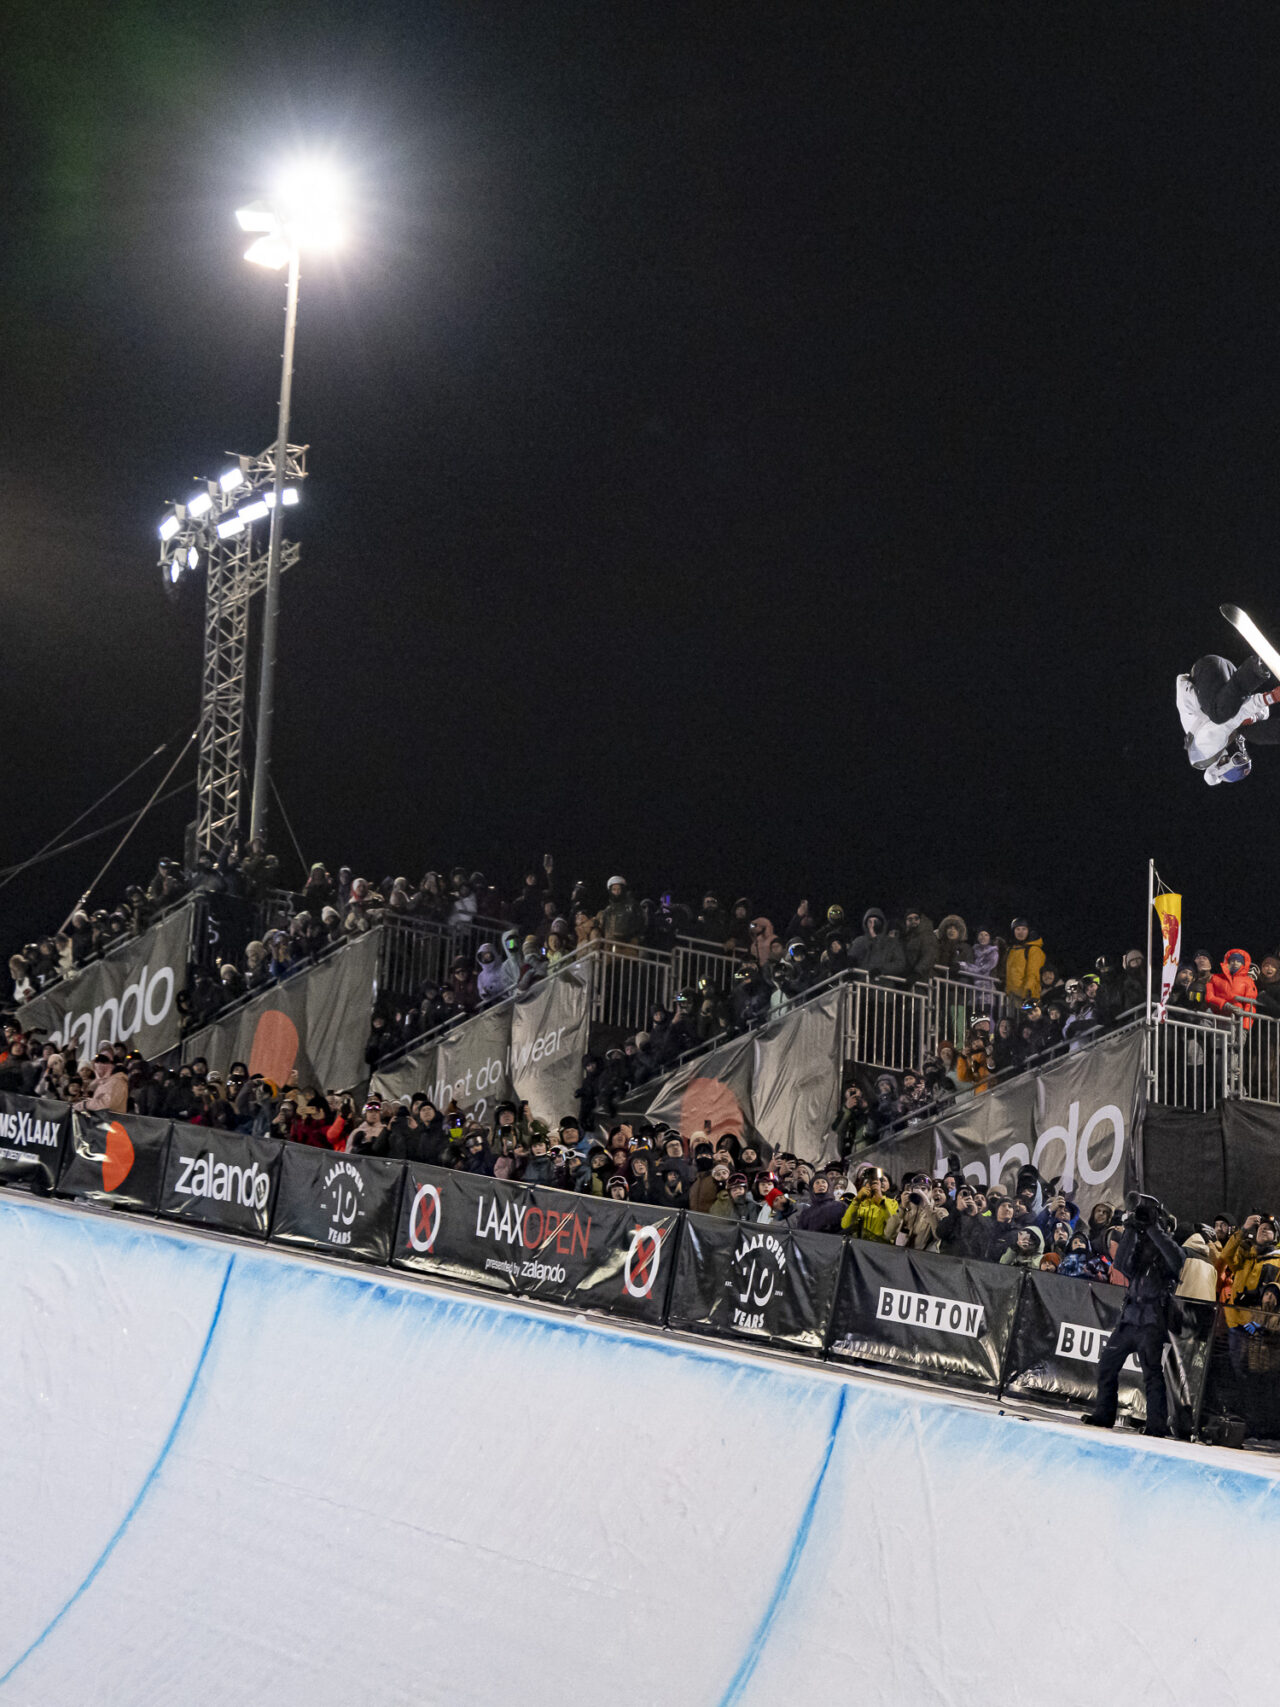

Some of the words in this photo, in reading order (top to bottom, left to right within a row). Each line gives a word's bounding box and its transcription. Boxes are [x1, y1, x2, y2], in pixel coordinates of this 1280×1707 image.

[476, 1057, 502, 1091] do
[512, 1027, 566, 1069] wear
[175, 1153, 270, 1210] zalando
[328, 1227, 352, 1245] YEARS
[735, 1233, 764, 1262] LAAX
[766, 1235, 786, 1270] OPEN
[485, 1258, 513, 1273] presented
[521, 1260, 566, 1283] zalando
[740, 1259, 775, 1307] 10
[733, 1308, 765, 1329] YEARS
[881, 1291, 979, 1334] BURTON
